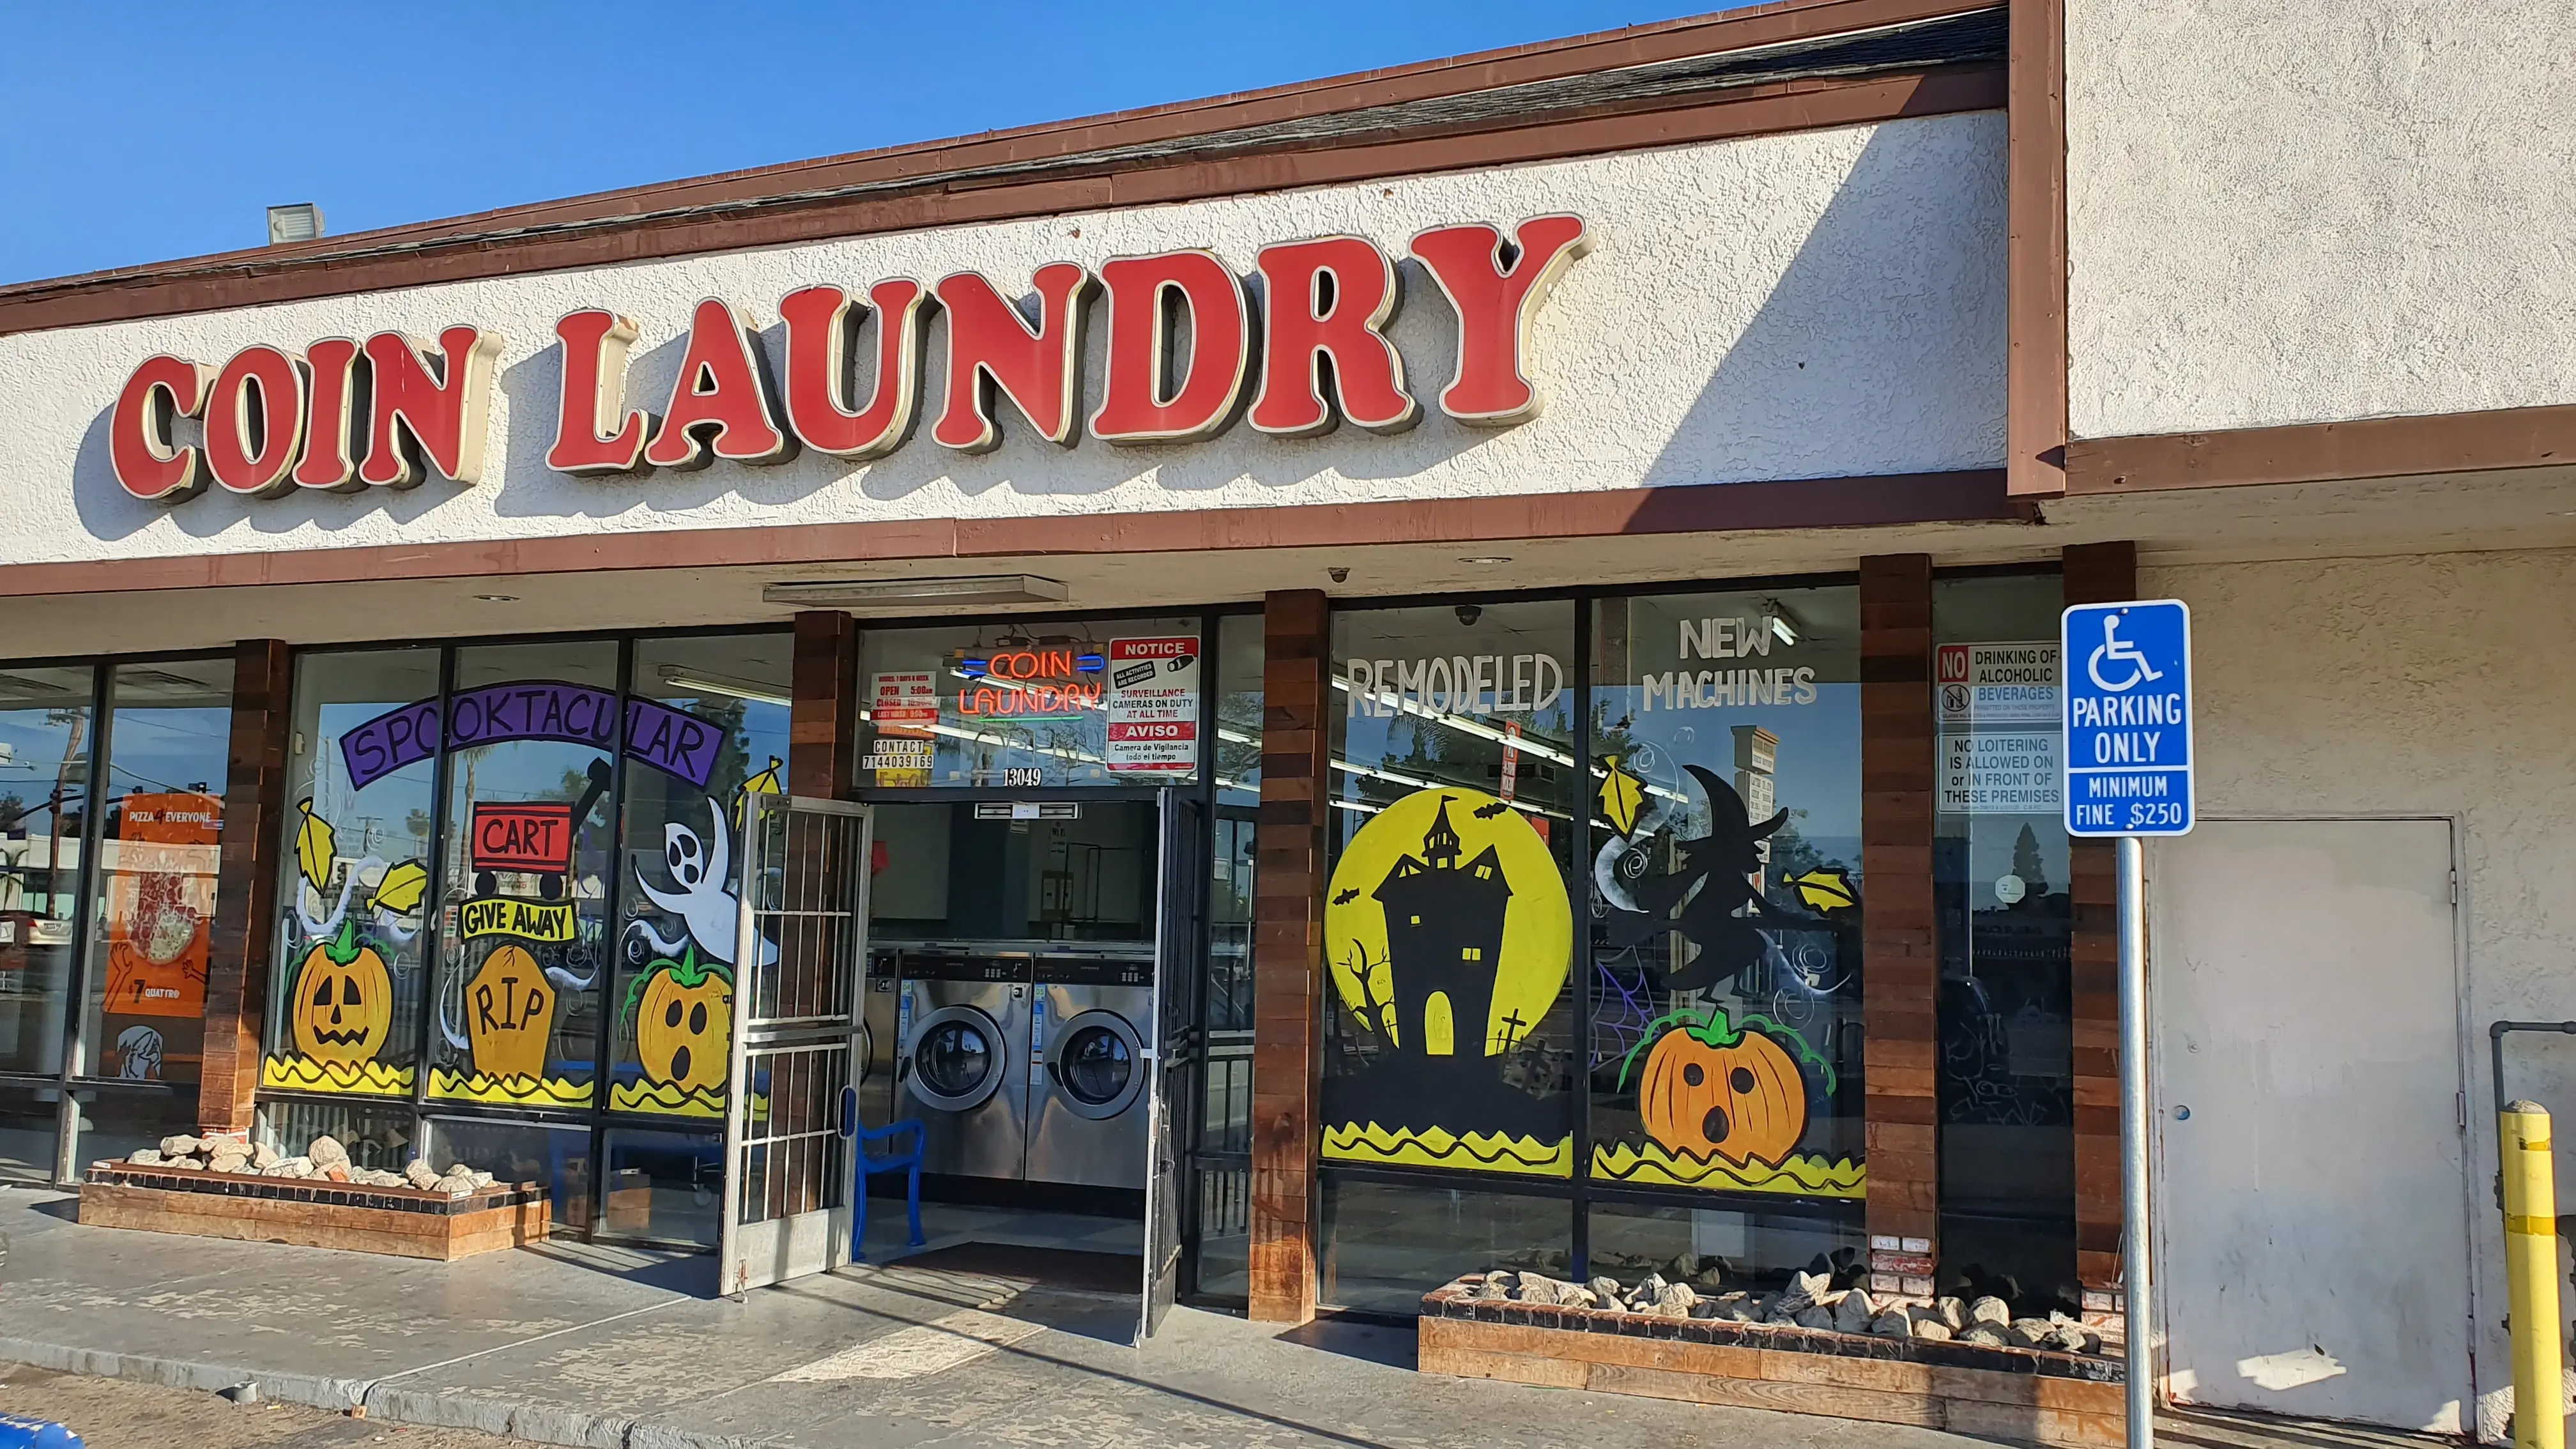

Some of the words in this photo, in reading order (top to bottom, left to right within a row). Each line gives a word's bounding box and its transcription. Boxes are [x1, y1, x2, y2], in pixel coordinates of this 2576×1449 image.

[109, 324, 489, 501] COIN
[544, 212, 1591, 473] LAUNDRY
[1680, 616, 1773, 659] NEW
[1125, 643, 1185, 655] NOTICE
[1975, 650, 2035, 664] DRINKING
[2040, 650, 2057, 663] OF
[990, 650, 1072, 680] COIN
[1116, 671, 1125, 680] ALL
[1125, 664, 1152, 676] ACTIVITIES
[1942, 651, 1966, 678] NO
[1118, 678, 1128, 687] ARE
[1128, 671, 1153, 684] RECORDED
[1979, 668, 2052, 682] ALCOHOLIC
[880, 686, 900, 696] OPEN
[1121, 689, 1185, 698] SURVEILLANCE
[1347, 654, 1563, 717] REMODELED
[1643, 667, 1817, 712] MACHINES
[959, 682, 1102, 714] LAUNDRY
[1979, 687, 2053, 701] BEVERAGES
[877, 698, 901, 707] CLOSED
[1113, 700, 1153, 709] CAMERAS
[1170, 699, 1193, 707] DUTY
[2073, 693, 2181, 727] PARKING
[354, 689, 706, 778] SPOOKTACULAR
[1125, 725, 1179, 737] AVISO
[875, 741, 923, 753] CONTACT
[1154, 743, 1188, 752] Vigilancia
[1954, 739, 1974, 752] NO
[1978, 739, 2048, 752] LOITERING
[2094, 732, 2161, 763] ONLY
[864, 756, 932, 768] 7144039169
[1950, 756, 1961, 769] IS
[1966, 756, 2029, 769] ALLOWED
[2034, 755, 2053, 769] ON
[1003, 768, 1041, 786] 13049
[1952, 776, 1964, 786] or
[1968, 773, 1981, 786] IN
[1986, 772, 2030, 786] FRONT
[2034, 772, 2052, 786] OF
[2089, 776, 2167, 798] MINIMUM
[1945, 790, 1987, 803] THESE
[1991, 790, 2059, 803] PREMISES
[129, 811, 154, 822] PIZZA
[154, 808, 165, 825] 4
[165, 811, 211, 823] EVERYONE
[2076, 804, 2115, 825] FINE
[2130, 802, 2182, 827] $250
[483, 818, 558, 857] CART
[464, 902, 507, 935] GIVE
[512, 903, 567, 939] AWAY
[145, 988, 180, 999] QUATTRO
[476, 977, 544, 1035] RIP
